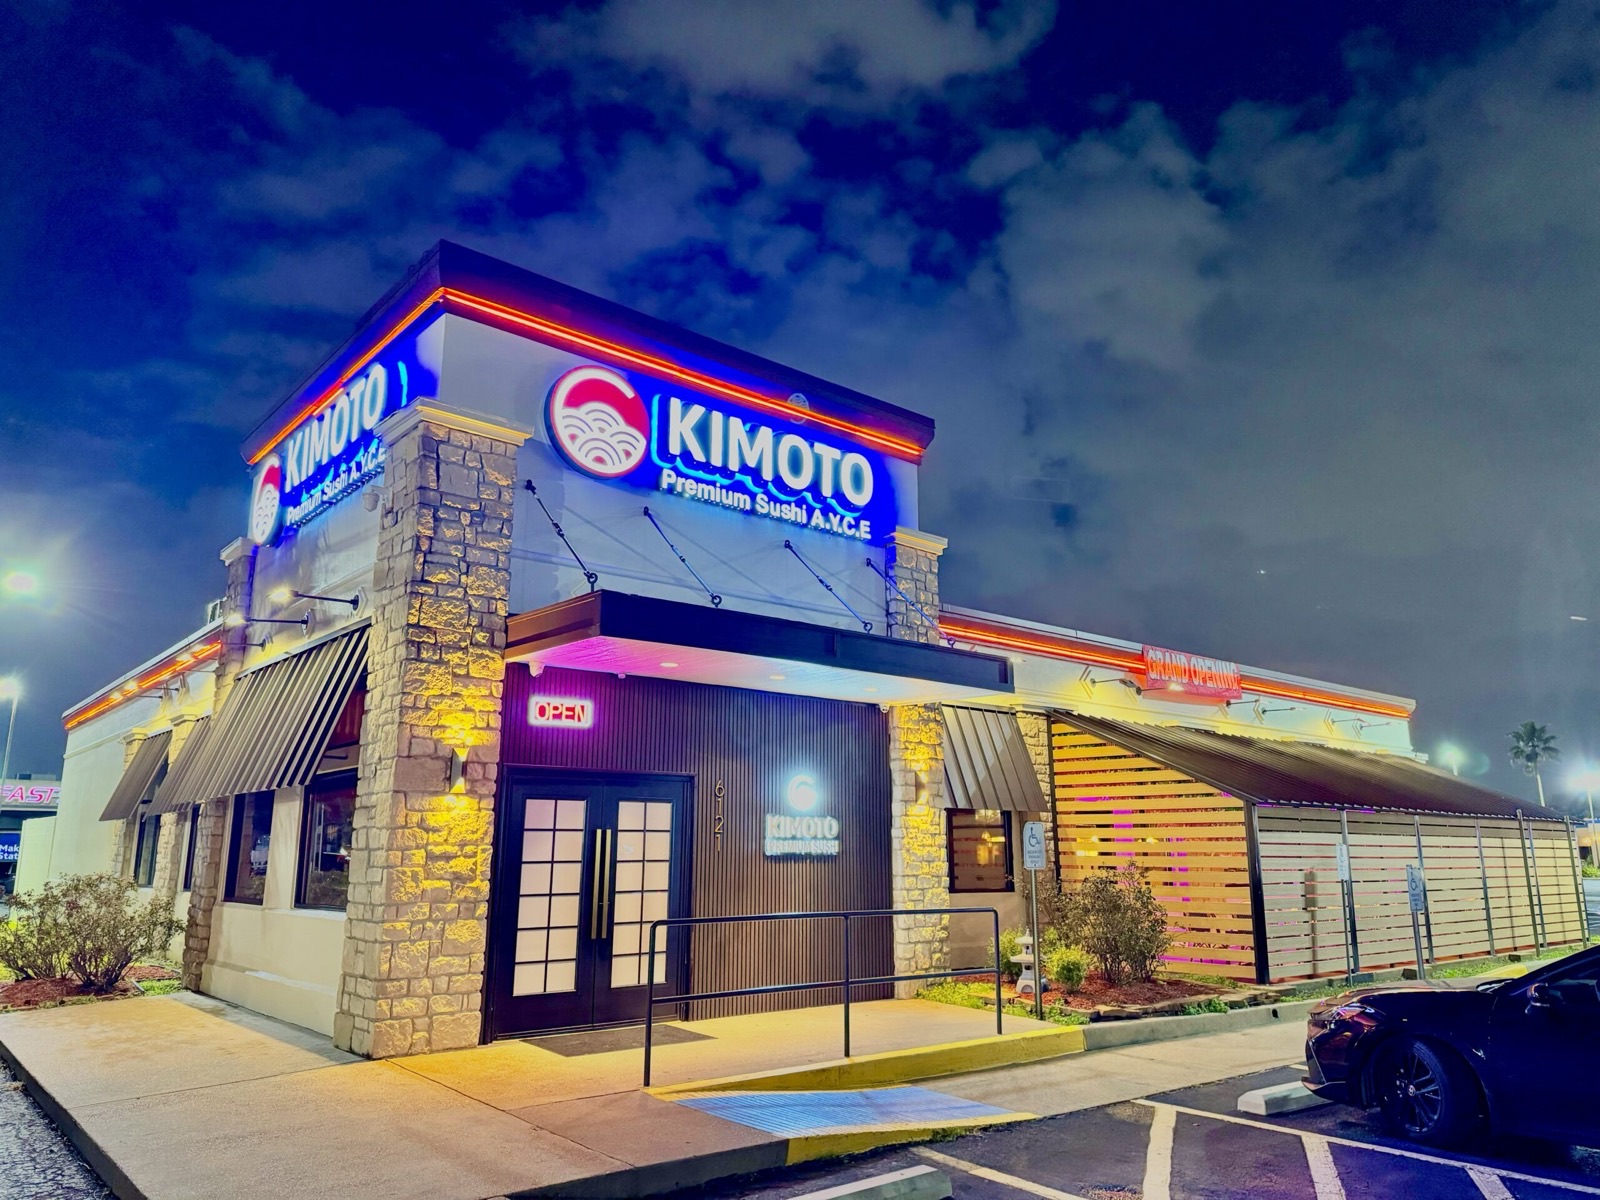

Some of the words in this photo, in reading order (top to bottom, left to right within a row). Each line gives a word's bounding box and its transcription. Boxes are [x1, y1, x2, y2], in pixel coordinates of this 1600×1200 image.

[285, 363, 386, 493] KIMOTO
[667, 396, 874, 507] KIMOTO
[286, 491, 322, 526] Premium
[323, 471, 349, 500] Sushi
[661, 468, 751, 511] Premium
[755, 493, 808, 525] Sushi
[811, 507, 872, 540] A.Y.C.E
[1147, 649, 1189, 684] GRAND
[1190, 656, 1240, 690] OPENING
[535, 701, 588, 723] OPEN
[766, 813, 839, 839] KIMOTO
[766, 839, 810, 855] PREMIUM
